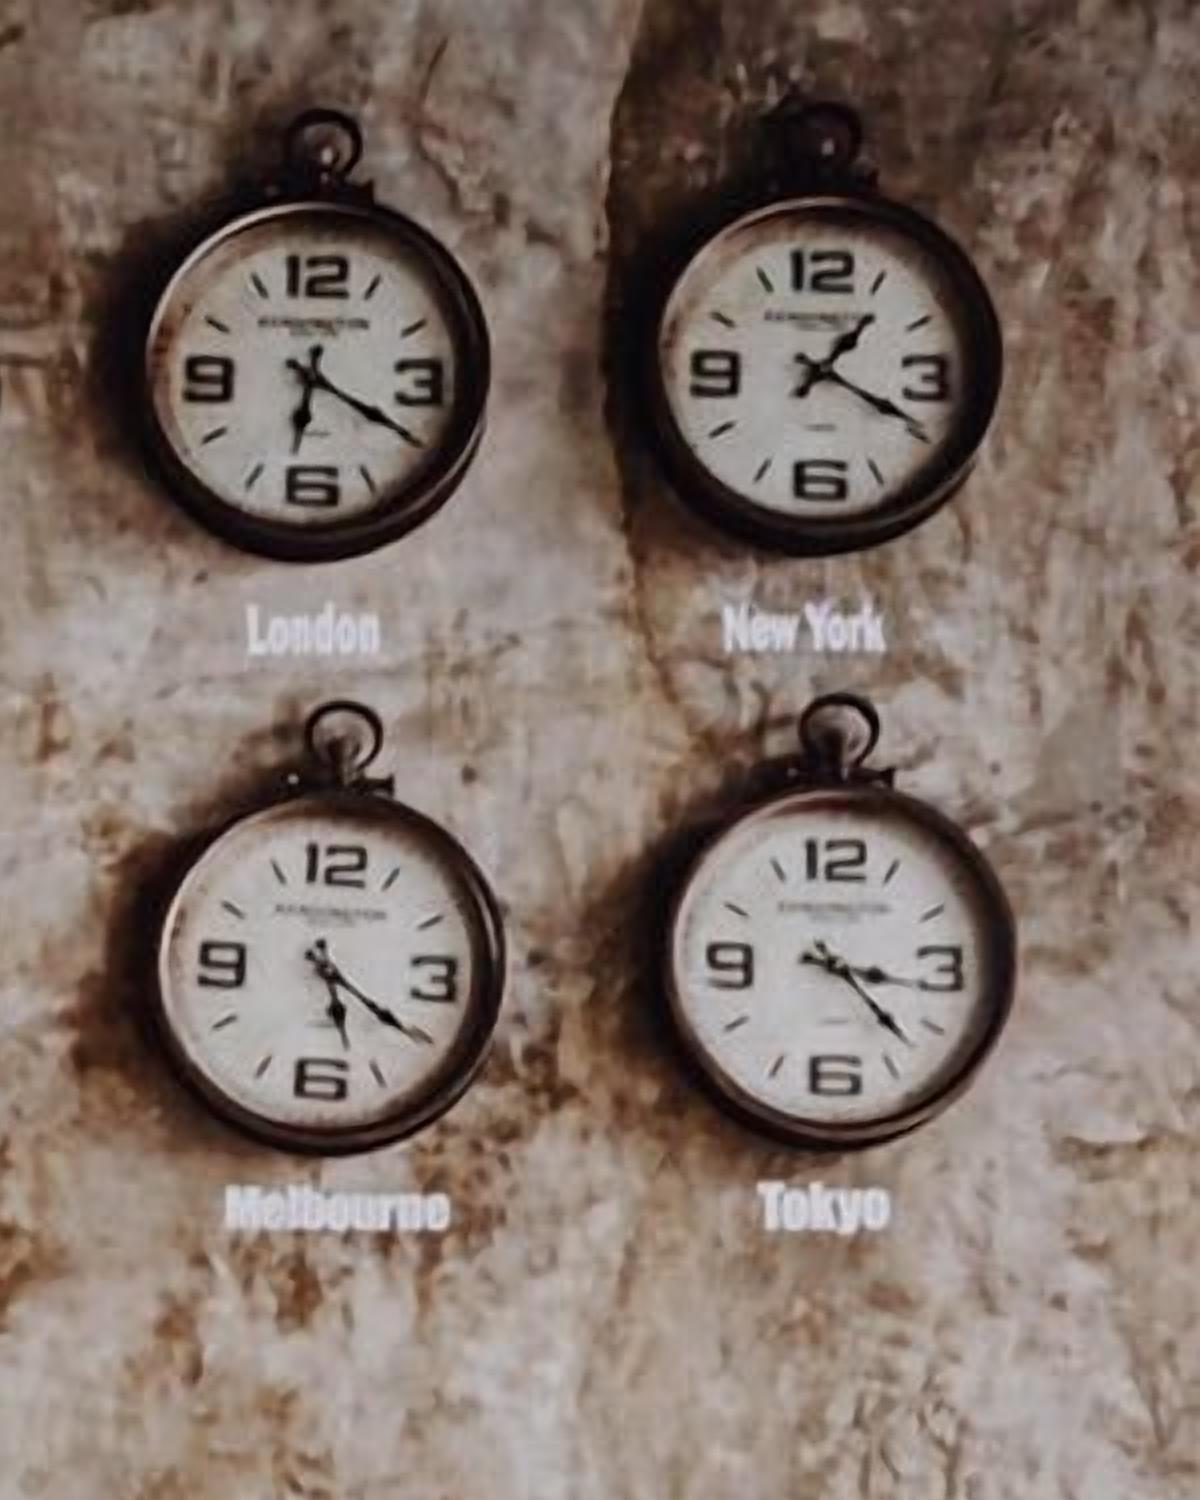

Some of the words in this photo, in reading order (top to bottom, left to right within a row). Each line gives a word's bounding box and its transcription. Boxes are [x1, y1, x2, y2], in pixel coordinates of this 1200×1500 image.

[286, 255, 349, 300] 12
[790, 248, 854, 294] 12
[182, 355, 234, 403] 9
[395, 359, 443, 406] 3
[689, 350, 741, 398] 9
[901, 354, 948, 402] 3
[285, 466, 340, 507] 6
[793, 459, 847, 501] 6
[245, 604, 382, 656] London
[722, 604, 799, 652] New
[804, 601, 886, 653] York
[304, 843, 368, 889] 12
[805, 839, 867, 882] 12
[198, 940, 247, 990] 9
[411, 955, 457, 1002] 3
[706, 942, 754, 990] 9
[916, 946, 964, 992] 3
[293, 1058, 349, 1100] 6
[808, 1055, 862, 1096] 6
[224, 1184, 451, 1232] Melbourne
[757, 1181, 893, 1233] Tokyo
